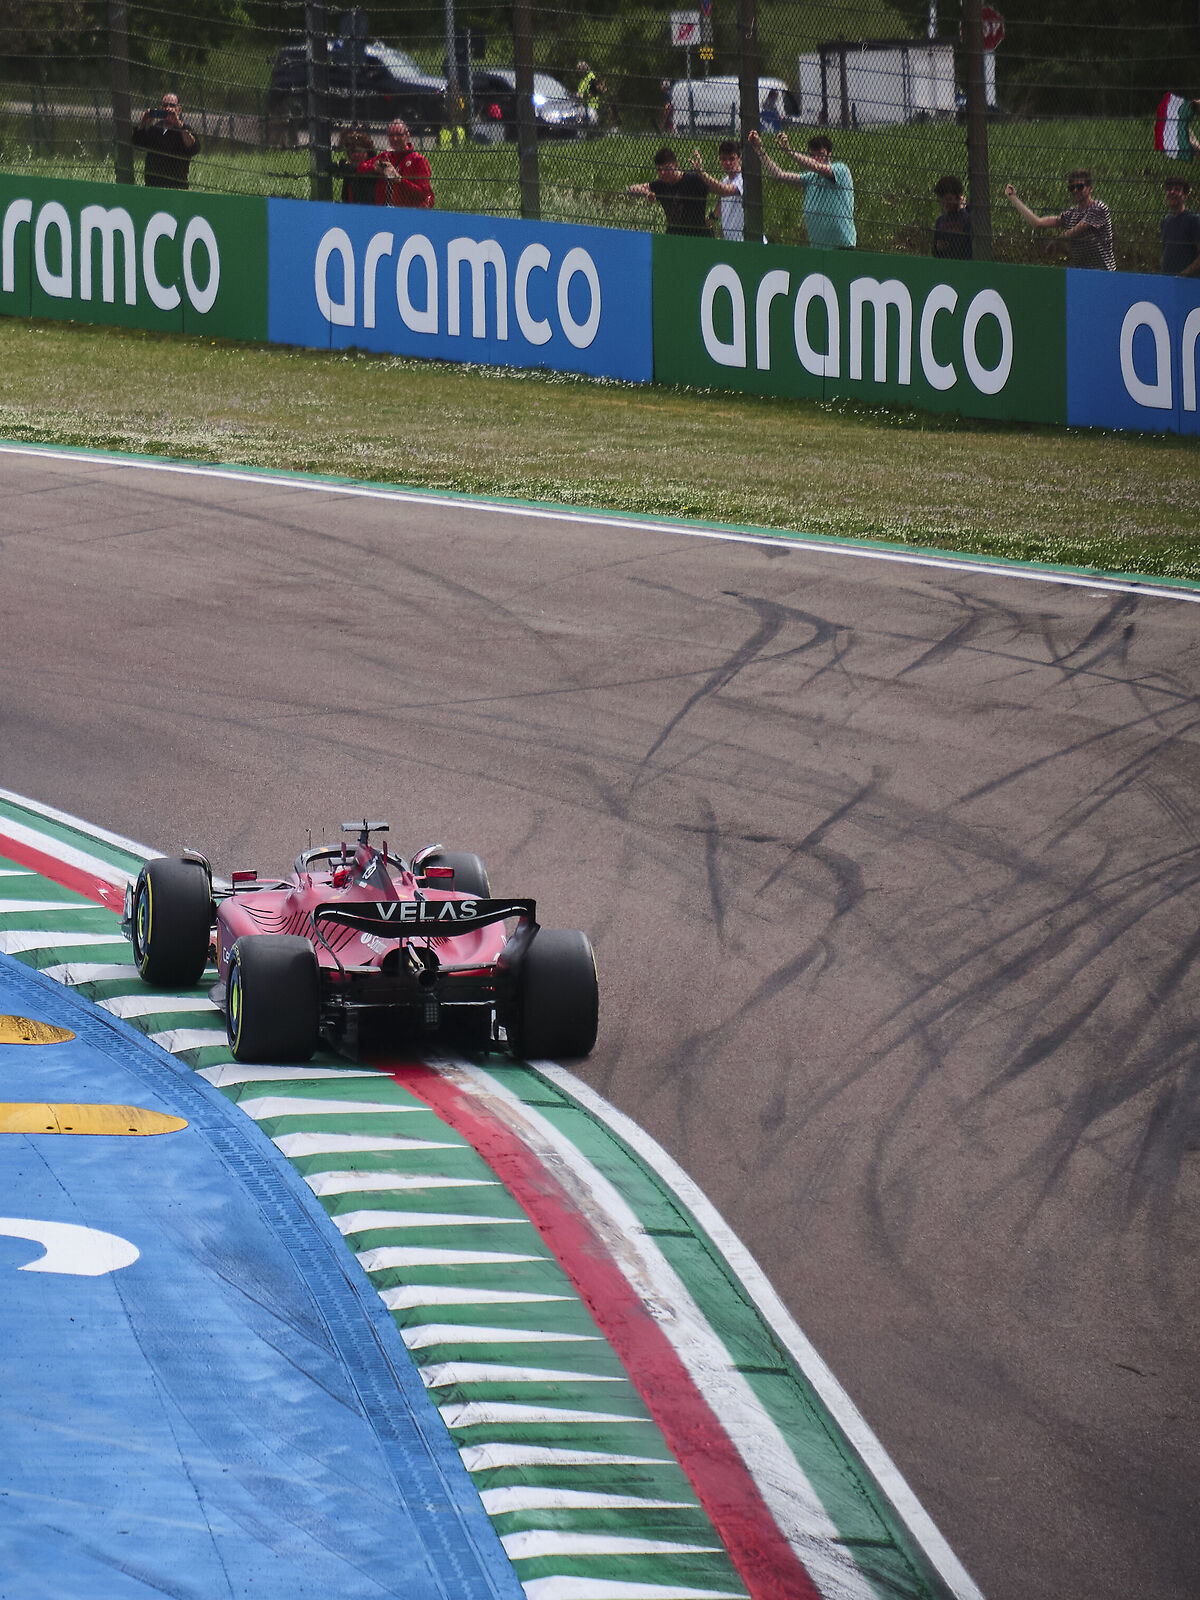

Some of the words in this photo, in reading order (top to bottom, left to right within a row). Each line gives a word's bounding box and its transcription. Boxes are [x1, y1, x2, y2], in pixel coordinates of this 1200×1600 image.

[315, 228, 602, 349] aramco
[700, 264, 1013, 395] aramco
[376, 901, 478, 921] VELAS
